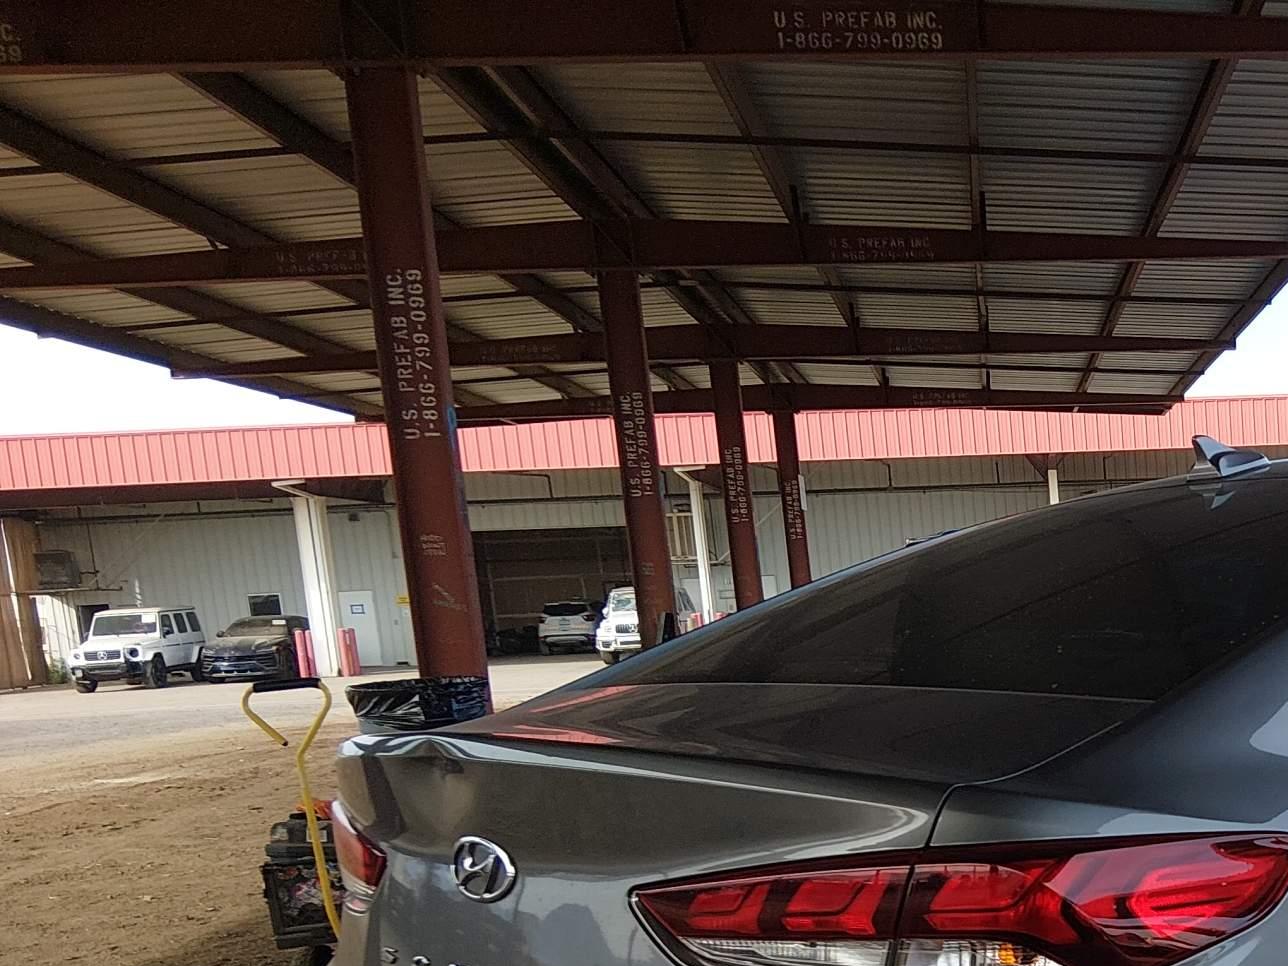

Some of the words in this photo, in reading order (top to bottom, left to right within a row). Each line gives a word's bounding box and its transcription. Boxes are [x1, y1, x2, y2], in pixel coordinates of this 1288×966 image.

[777, 32, 943, 49] 1-866-799-0969
[822, 11, 897, 29] PREFAB
[907, 11, 943, 29] INC.
[386, 268, 405, 305] INC.
[391, 315, 415, 392] PREFAB
[406, 269, 441, 438] 1-866-799-0969
[623, 420, 638, 468] PREFAB
